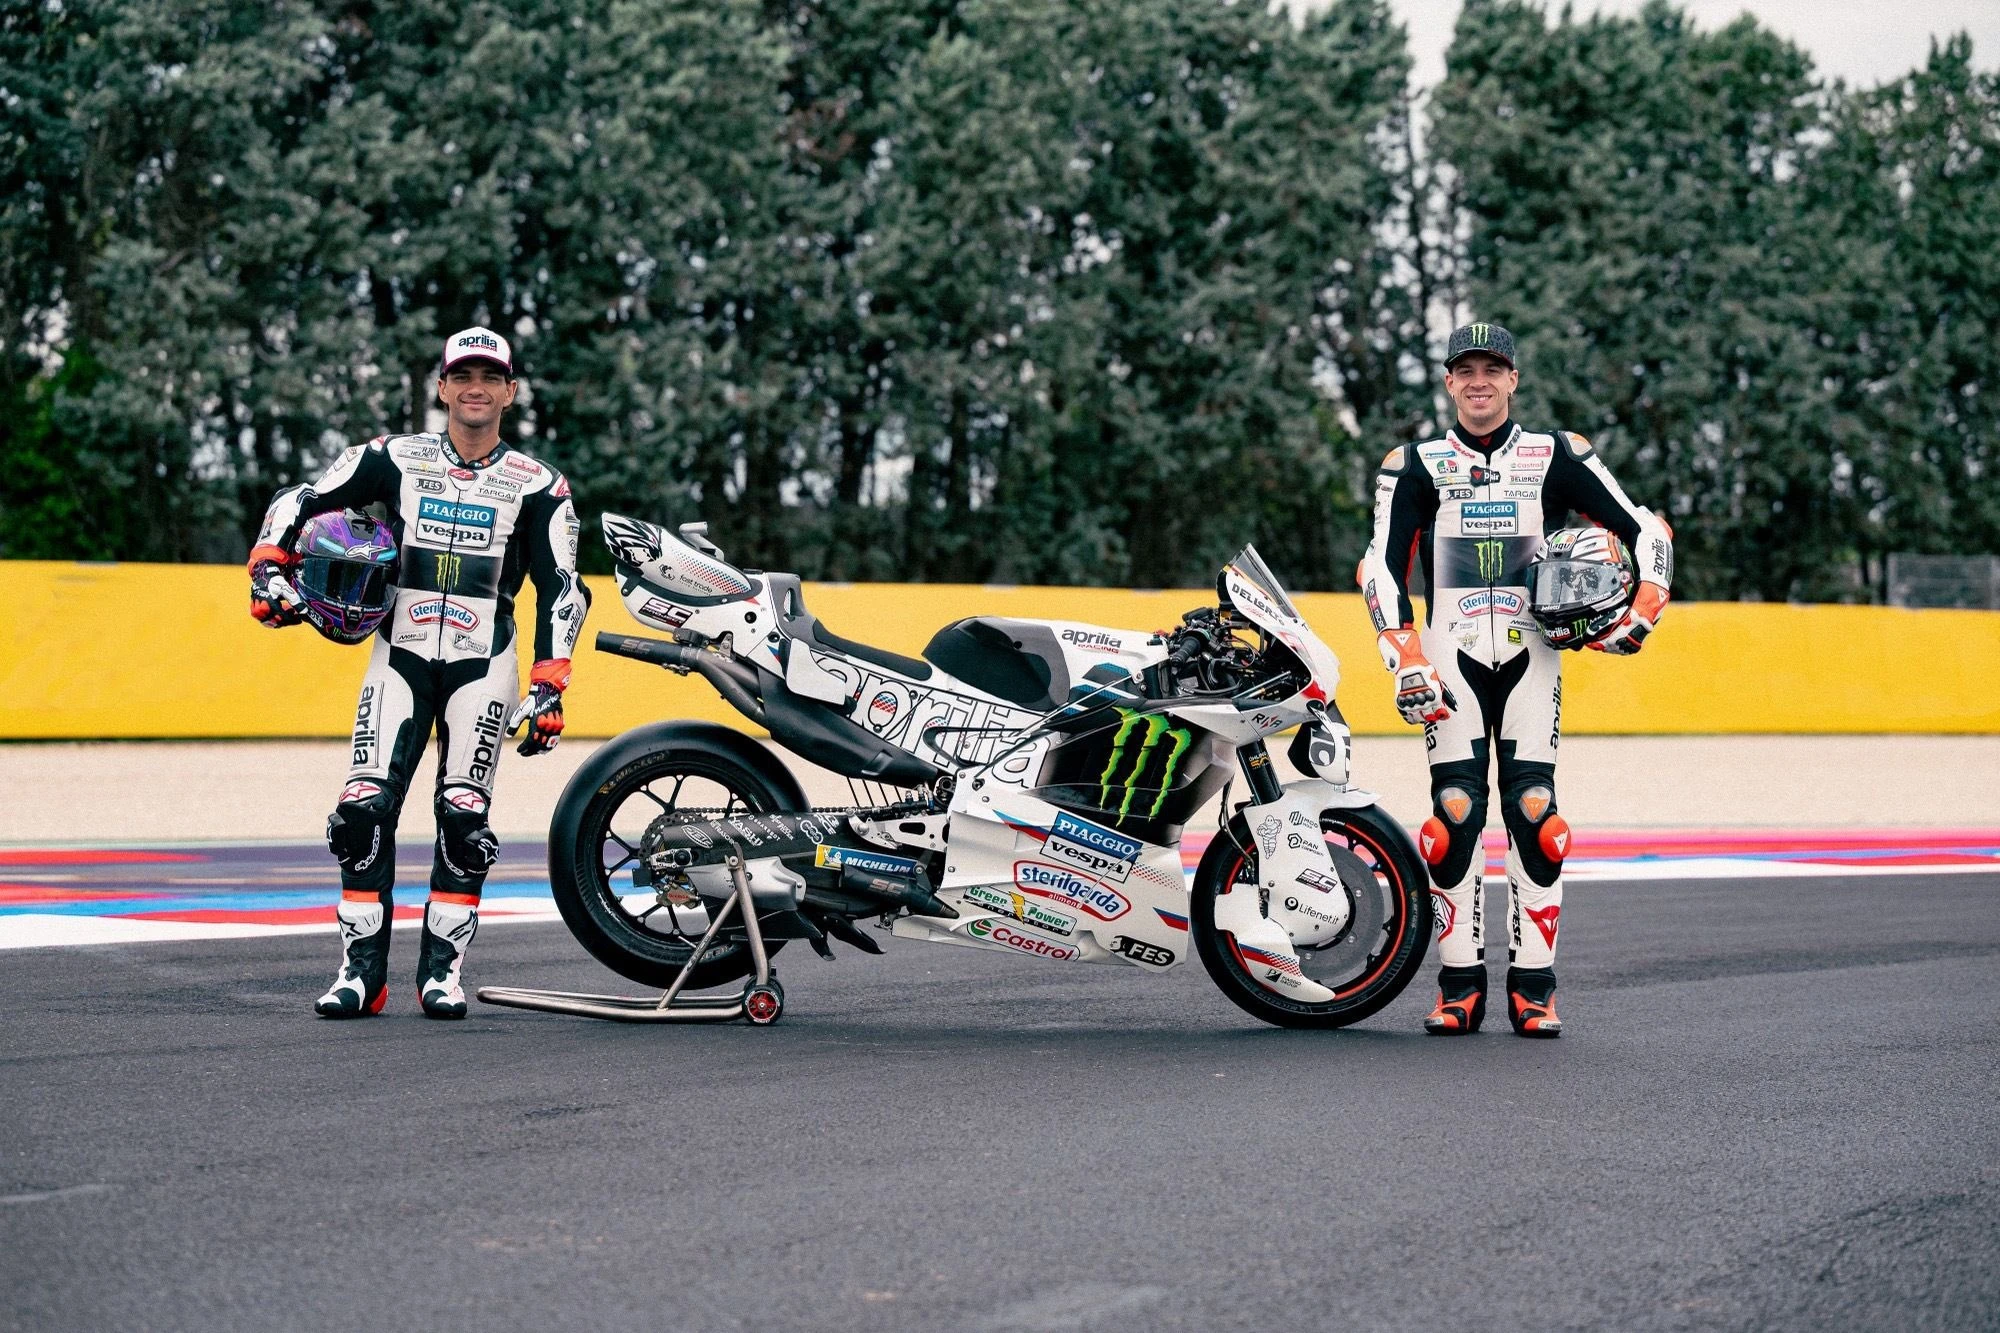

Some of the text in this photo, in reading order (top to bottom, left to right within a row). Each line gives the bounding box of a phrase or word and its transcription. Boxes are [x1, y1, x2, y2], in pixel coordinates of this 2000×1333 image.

[458, 334, 498, 347] aprilia
[503, 469, 528, 480] Castrol
[478, 487, 512, 500] TARGA
[1454, 490, 1472, 498] FES
[1504, 490, 1535, 498] TARGA
[422, 500, 491, 522] PIAGGIO
[1463, 504, 1514, 514] PIAGGIO
[421, 523, 487, 543] vespa
[1464, 519, 1514, 531] vespa
[1653, 538, 1667, 576] aprilia
[564, 608, 584, 647] aprilia
[1061, 628, 1122, 649] aprilia
[1077, 643, 1120, 655] RACING
[353, 685, 375, 766] aprilia
[468, 699, 505, 782] aprilia
[728, 816, 764, 847] YASHI
[1057, 818, 1136, 857] PIAGGIO
[1302, 839, 1319, 850] PAN
[844, 856, 911, 873] MICHELIN
[1050, 839, 1125, 875] vespa
[1022, 866, 1120, 913] sterilgarda
[969, 886, 1069, 928] Green Power
[1298, 903, 1339, 925] Lifenet.it
[992, 927, 1075, 961] Castrol
[1128, 941, 1171, 965] FES
